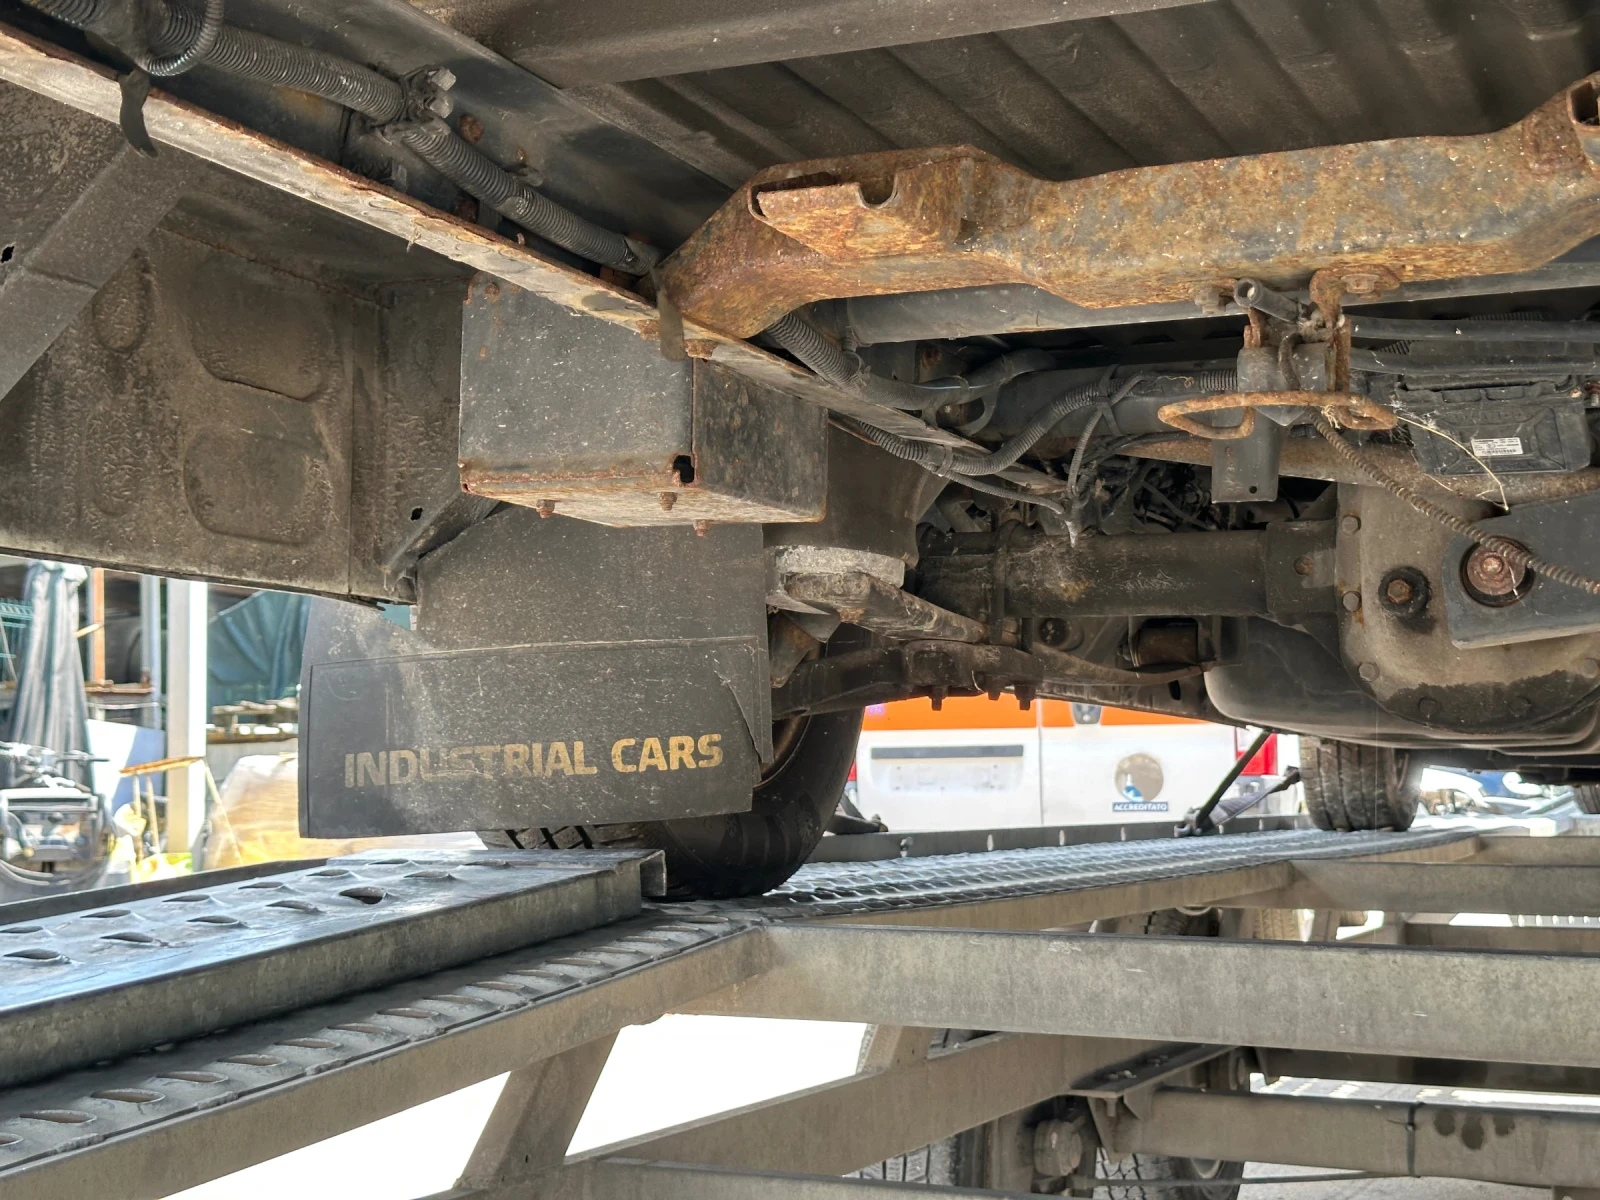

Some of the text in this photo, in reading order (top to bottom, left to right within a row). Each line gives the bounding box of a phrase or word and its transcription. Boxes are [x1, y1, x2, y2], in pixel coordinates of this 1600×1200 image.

[344, 733, 723, 788] INDUSTRIAL CARS
[1113, 803, 1168, 811] ACCREDITATO
